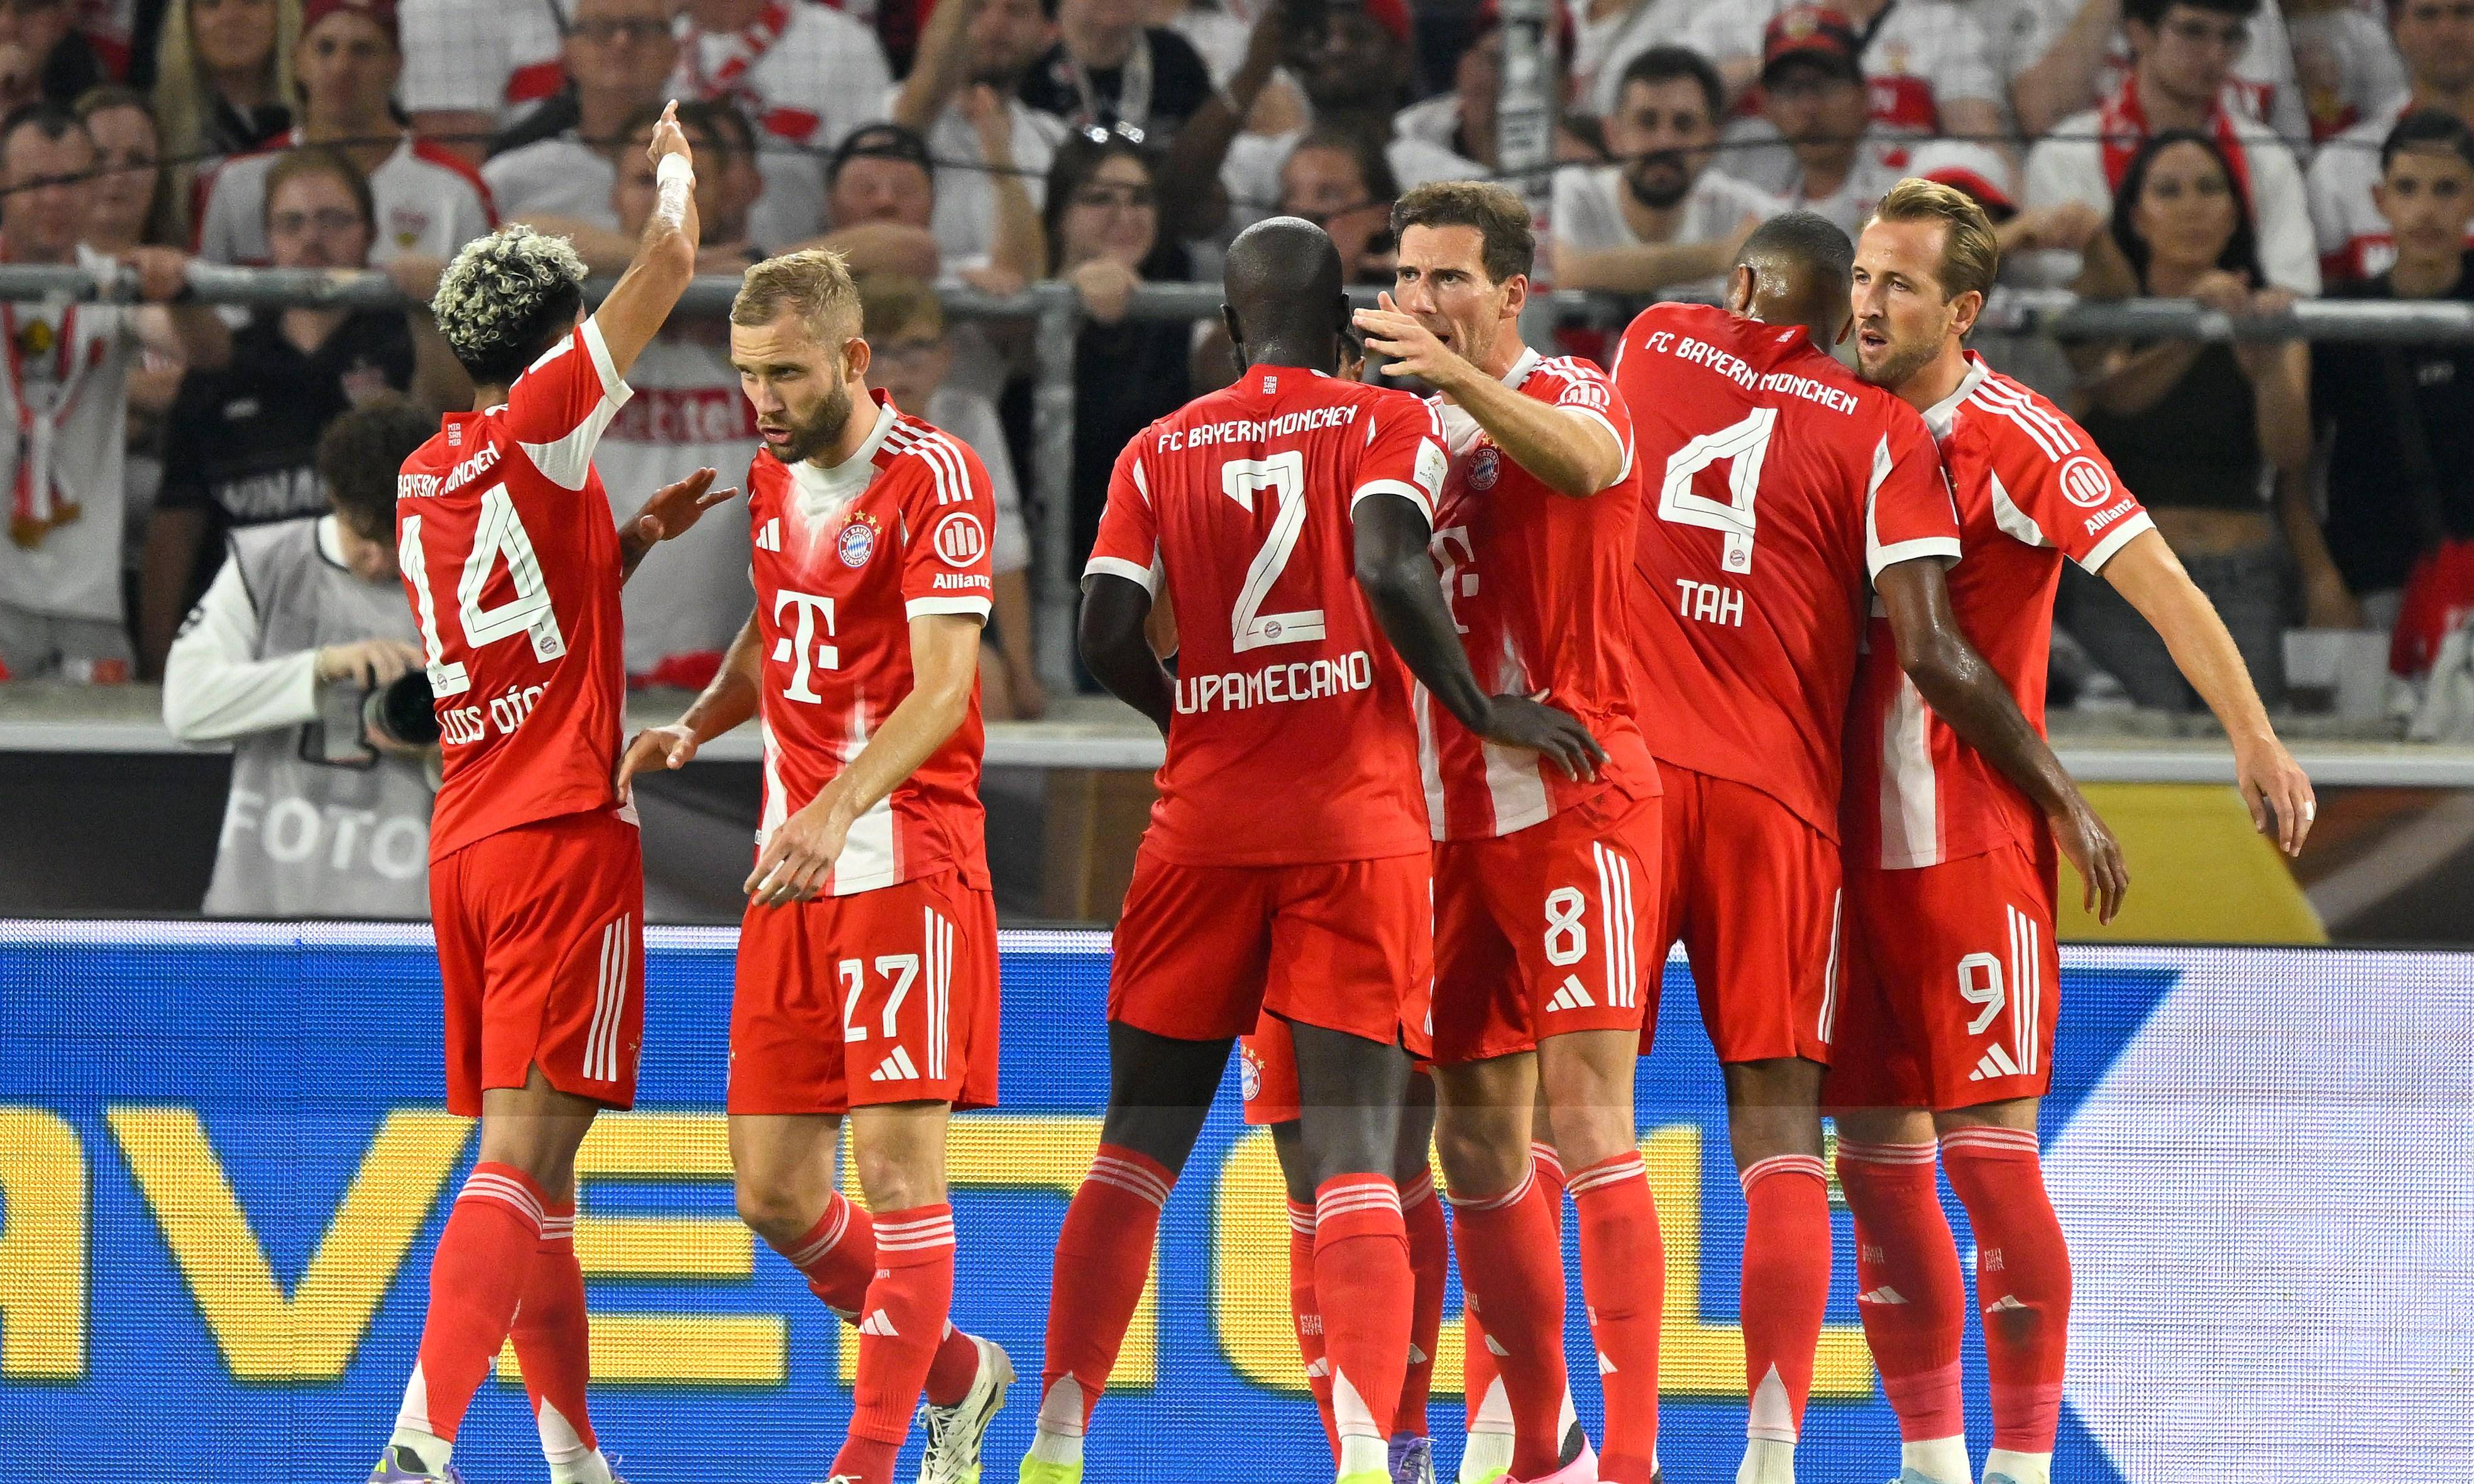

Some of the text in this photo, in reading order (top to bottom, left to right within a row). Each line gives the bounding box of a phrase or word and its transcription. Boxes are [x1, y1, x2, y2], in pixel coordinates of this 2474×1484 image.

[1644, 331, 1859, 415] FC BAYERN MÜNCHEN
[1158, 405, 1358, 454] FC BAYERN MÜNCHEN
[1659, 407, 1778, 575] 4
[2084, 498, 2136, 537] Allianz
[399, 481, 566, 699] 14
[932, 573, 990, 590] Allianz
[1222, 450, 1326, 653] 2
[1676, 578, 1744, 627] TAH
[772, 590, 838, 704] T
[1175, 651, 1372, 714] UPAMECANO
[435, 681, 551, 745] LUIS DÍA
[219, 788, 429, 879] FOTO
[1544, 886, 1587, 967] 8
[838, 954, 919, 1043] 27
[1957, 952, 2006, 1035] 9
